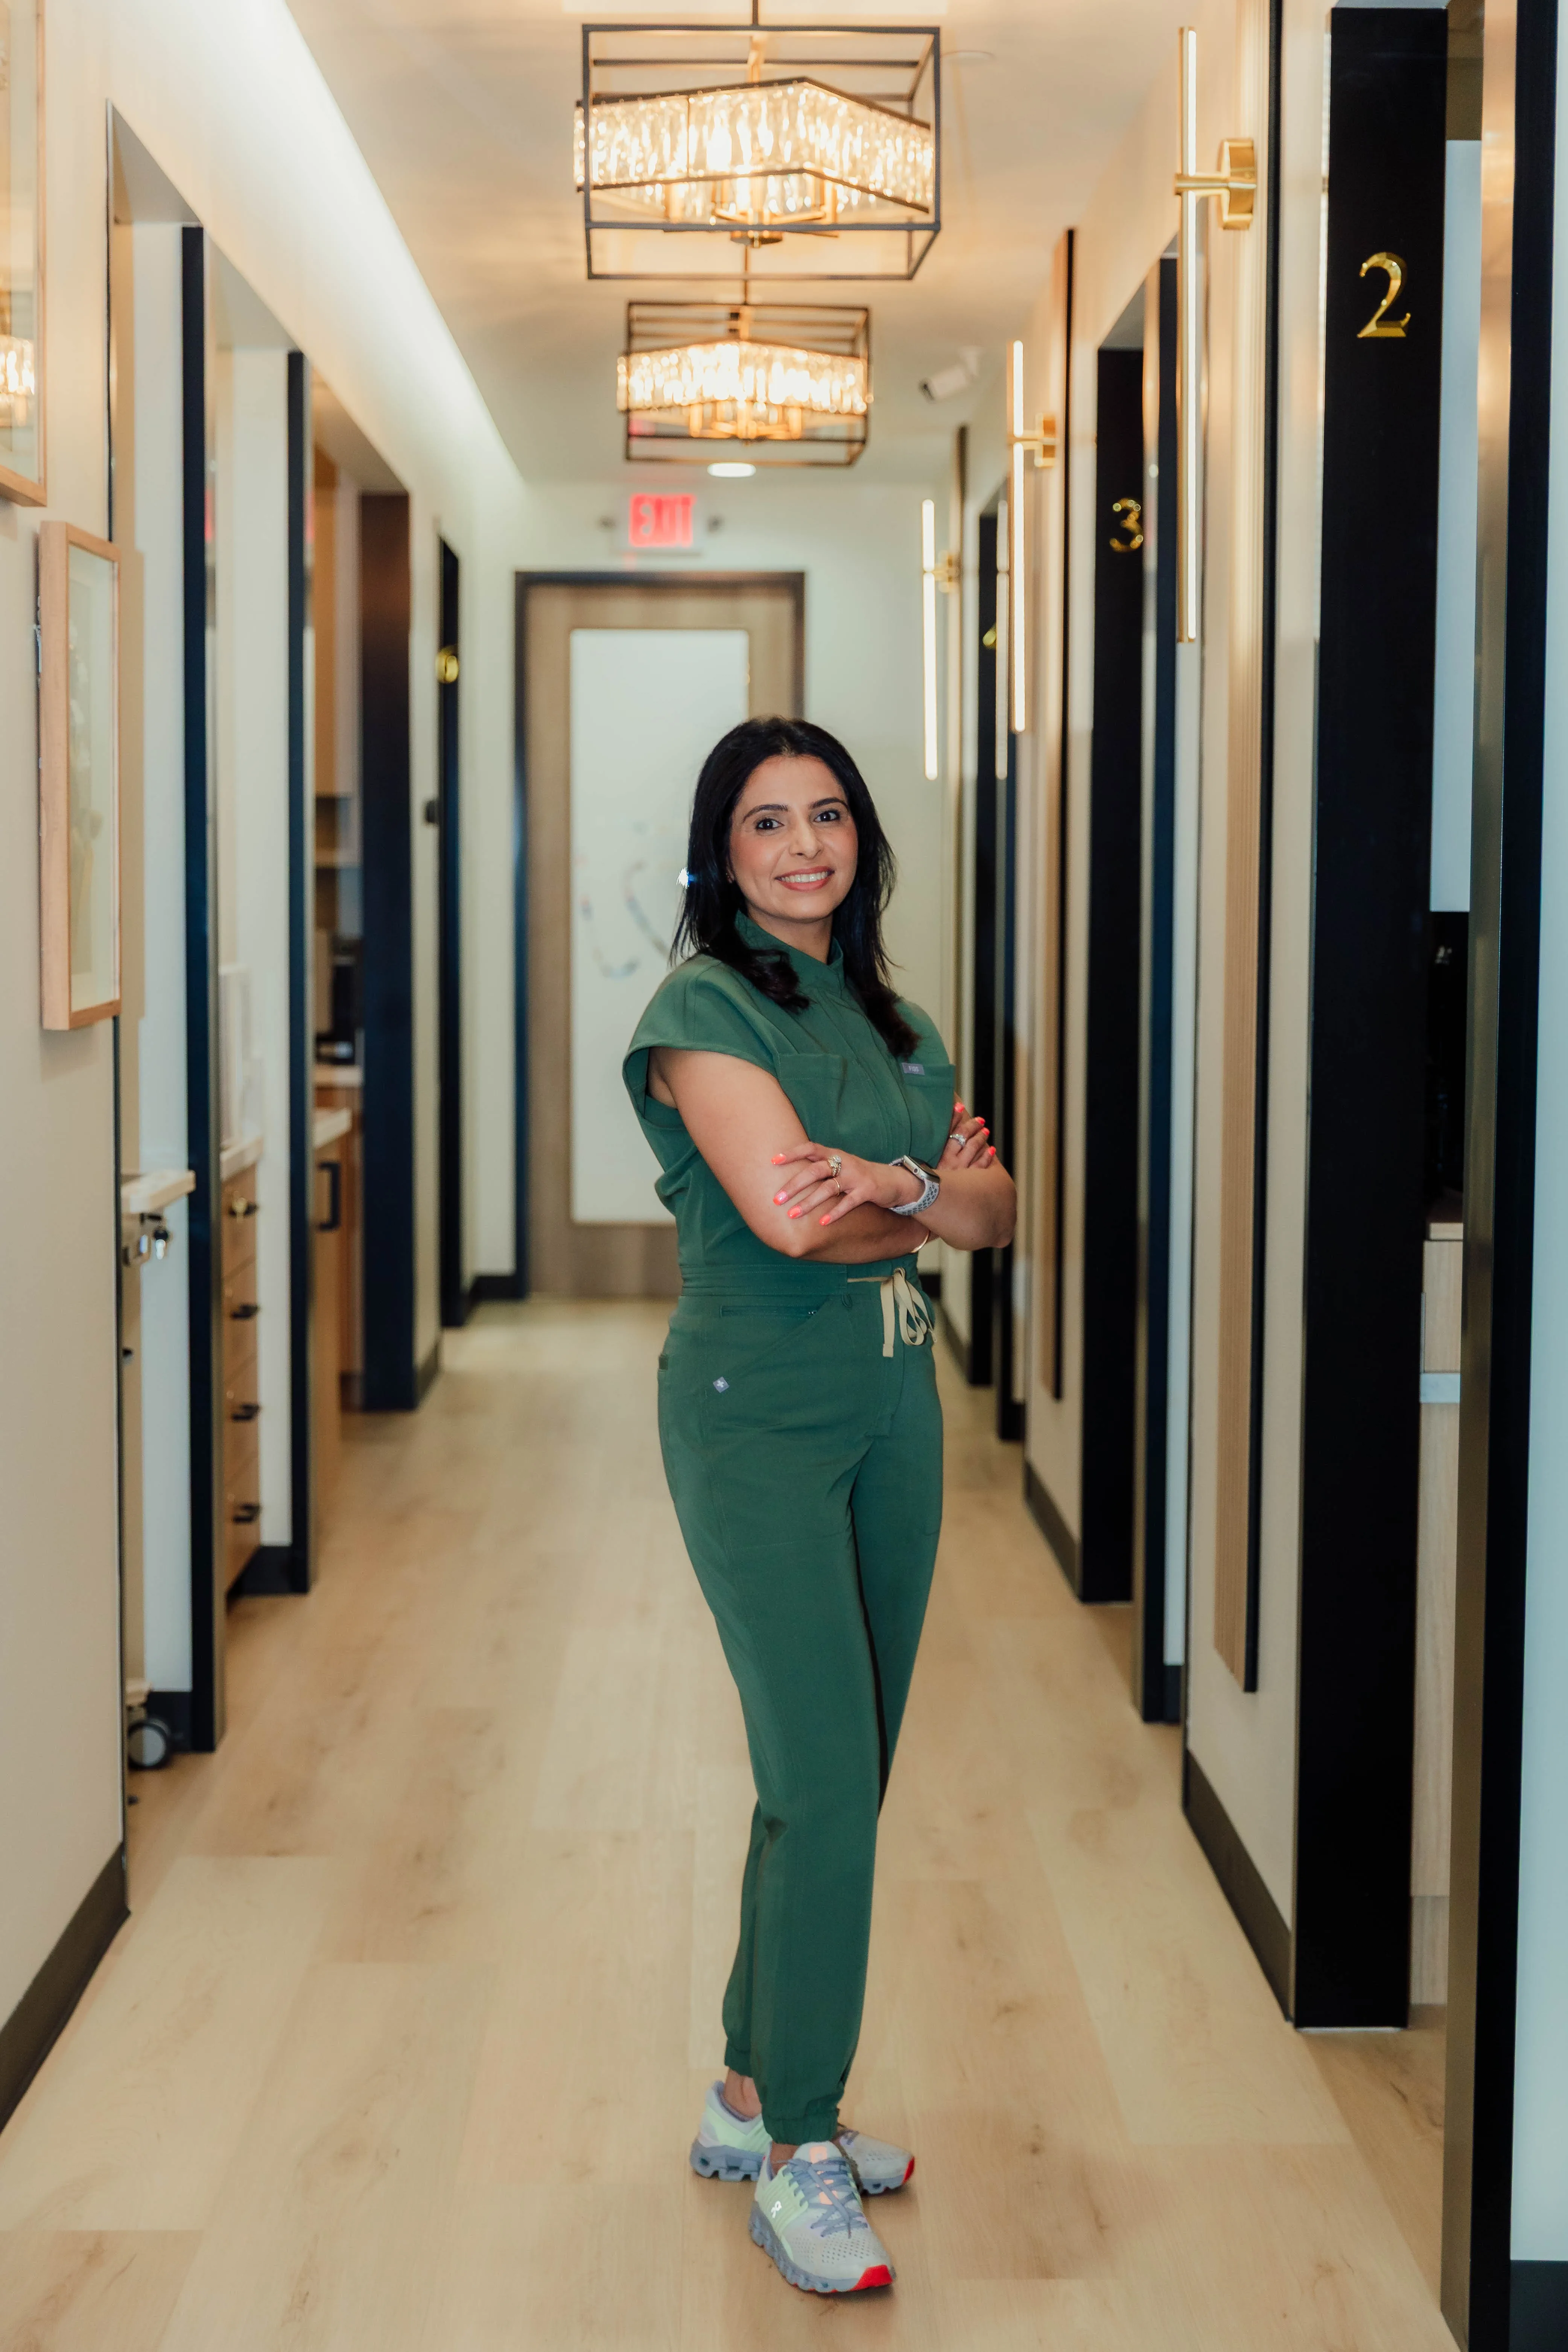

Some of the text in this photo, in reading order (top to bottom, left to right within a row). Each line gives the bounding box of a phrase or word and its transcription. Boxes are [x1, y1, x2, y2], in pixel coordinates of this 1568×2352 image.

[1357, 252, 1411, 338] 2
[630, 493, 695, 547] EXIT
[1109, 498, 1144, 552] 3
